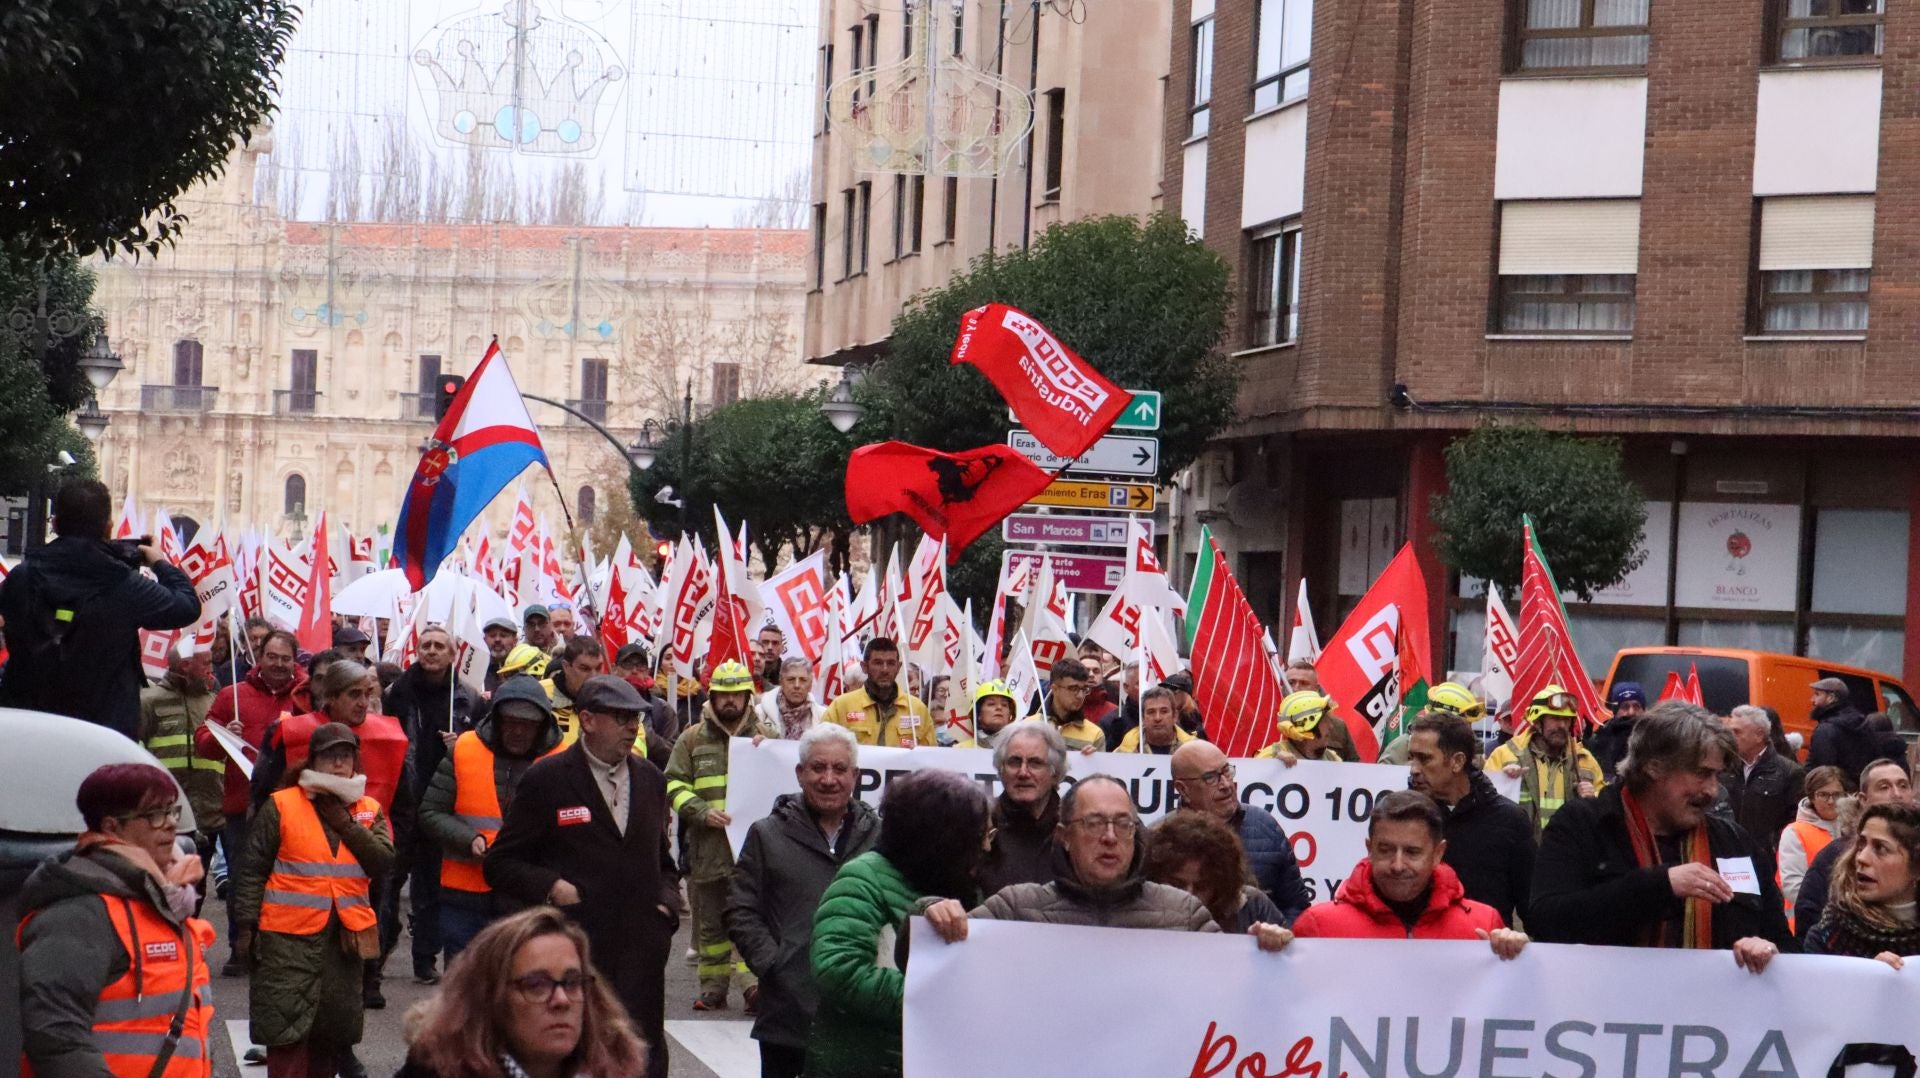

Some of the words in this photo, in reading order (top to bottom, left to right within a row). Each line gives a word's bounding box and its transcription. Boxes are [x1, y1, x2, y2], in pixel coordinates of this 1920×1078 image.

[1016, 439, 1036, 448] Eras
[1080, 488, 1106, 499] Eras
[1012, 523, 1035, 535] San
[1043, 525, 1084, 537] Marcos
[1011, 556, 1040, 564] mueo
[1055, 559, 1074, 567] arte
[1716, 585, 1758, 595] BLANCO
[269, 589, 292, 610] ierzo
[694, 600, 714, 628] ierz
[560, 807, 589, 818] CCOO
[146, 943, 176, 954] CCOO
[1327, 1016, 1799, 1078] NUESTRA
